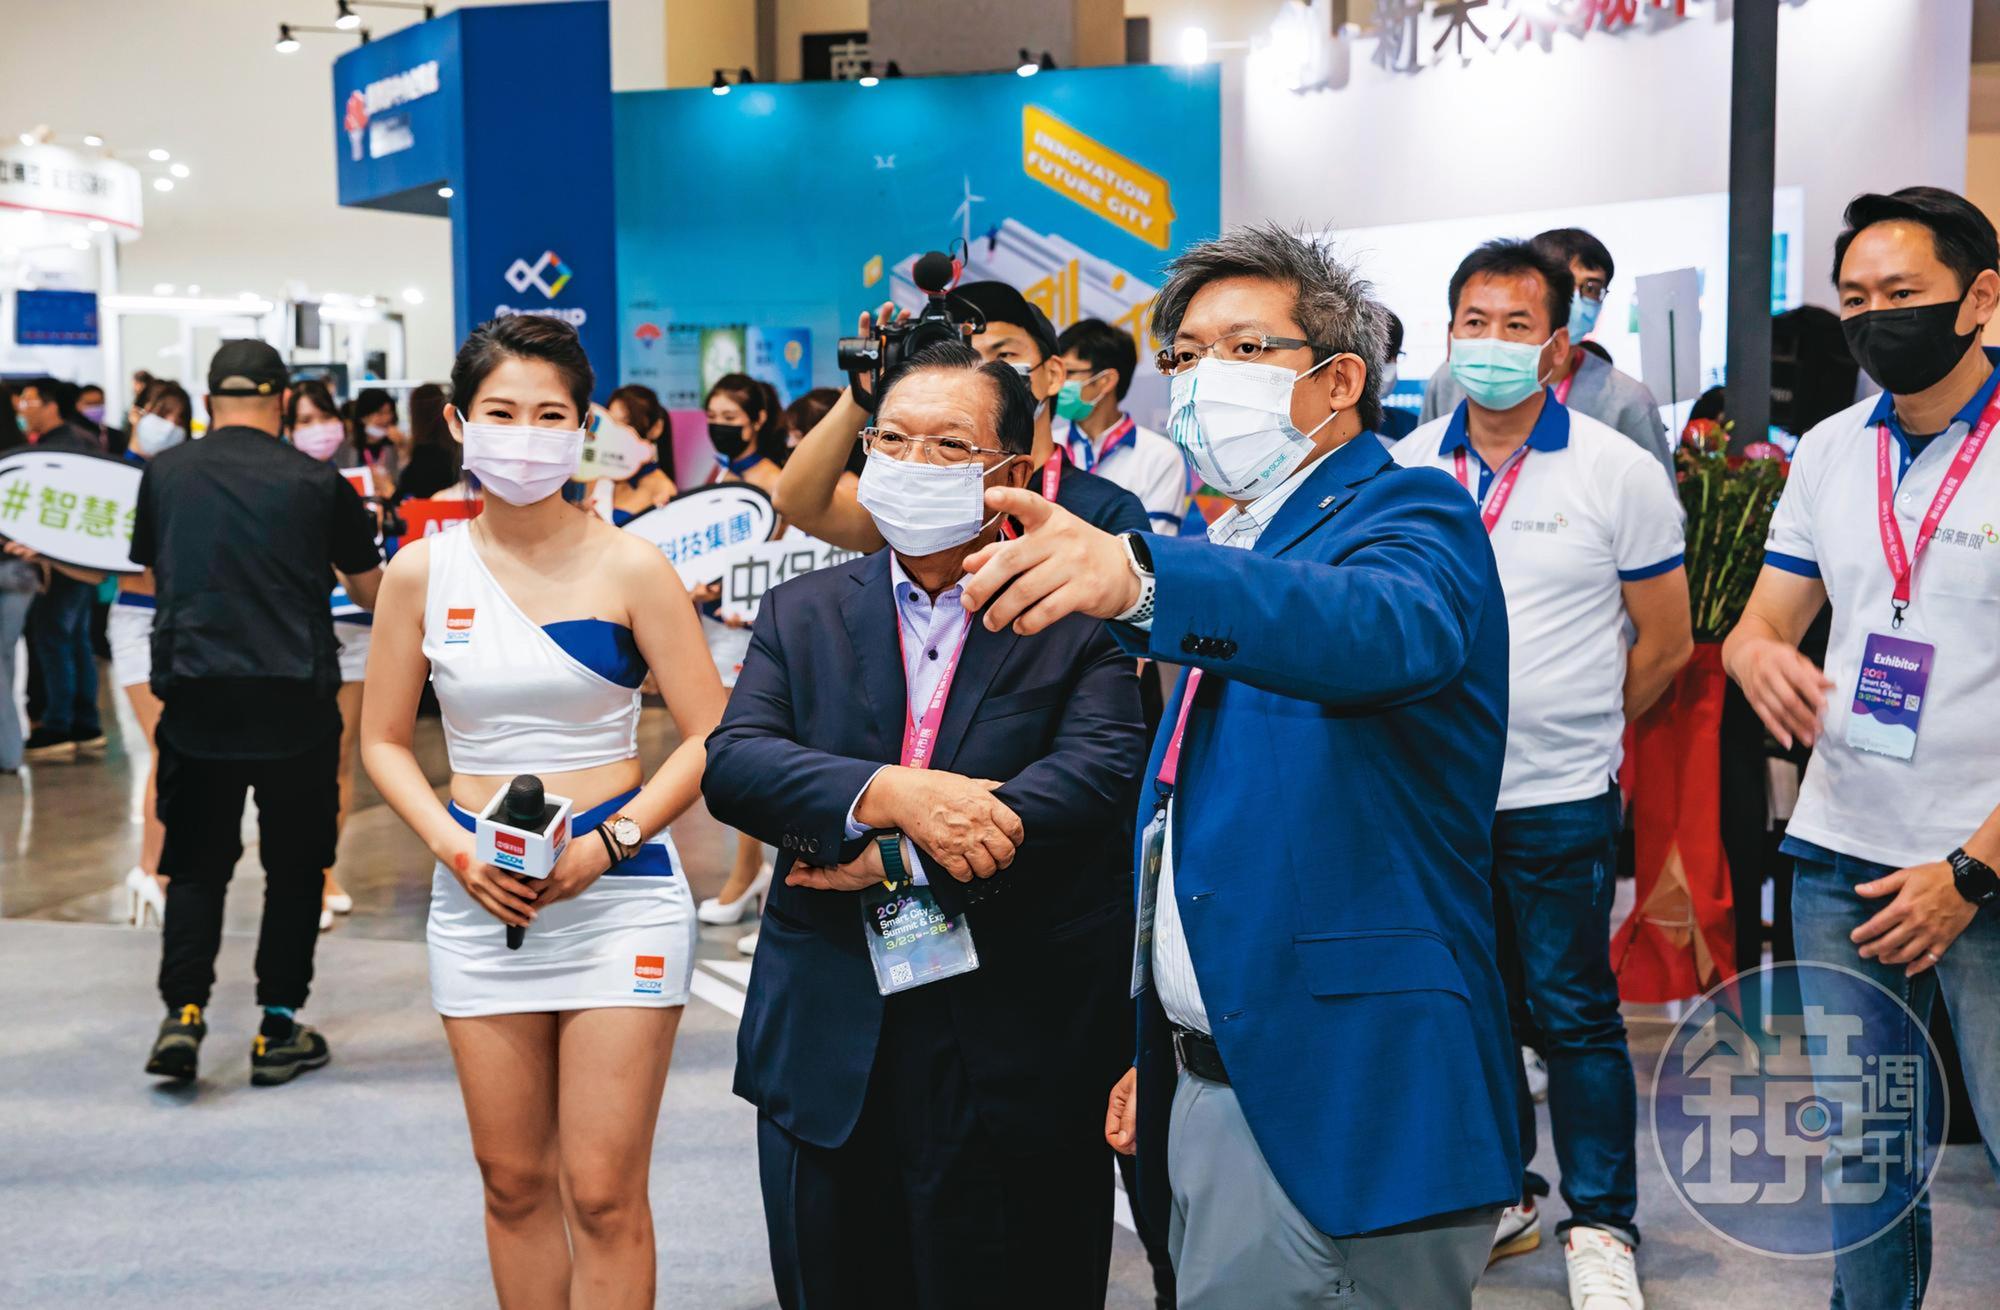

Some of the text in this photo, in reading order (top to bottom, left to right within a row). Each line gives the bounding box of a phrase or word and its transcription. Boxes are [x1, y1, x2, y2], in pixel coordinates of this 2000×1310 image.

[1034, 130, 1151, 207] INNOVATION
[1027, 151, 1152, 230] FUTURE CITY
[1873, 653, 1920, 672] Exhibitor
[880, 907, 928, 929] Smart City
[882, 922, 919, 939] Summit
[920, 918, 928, 927] &
